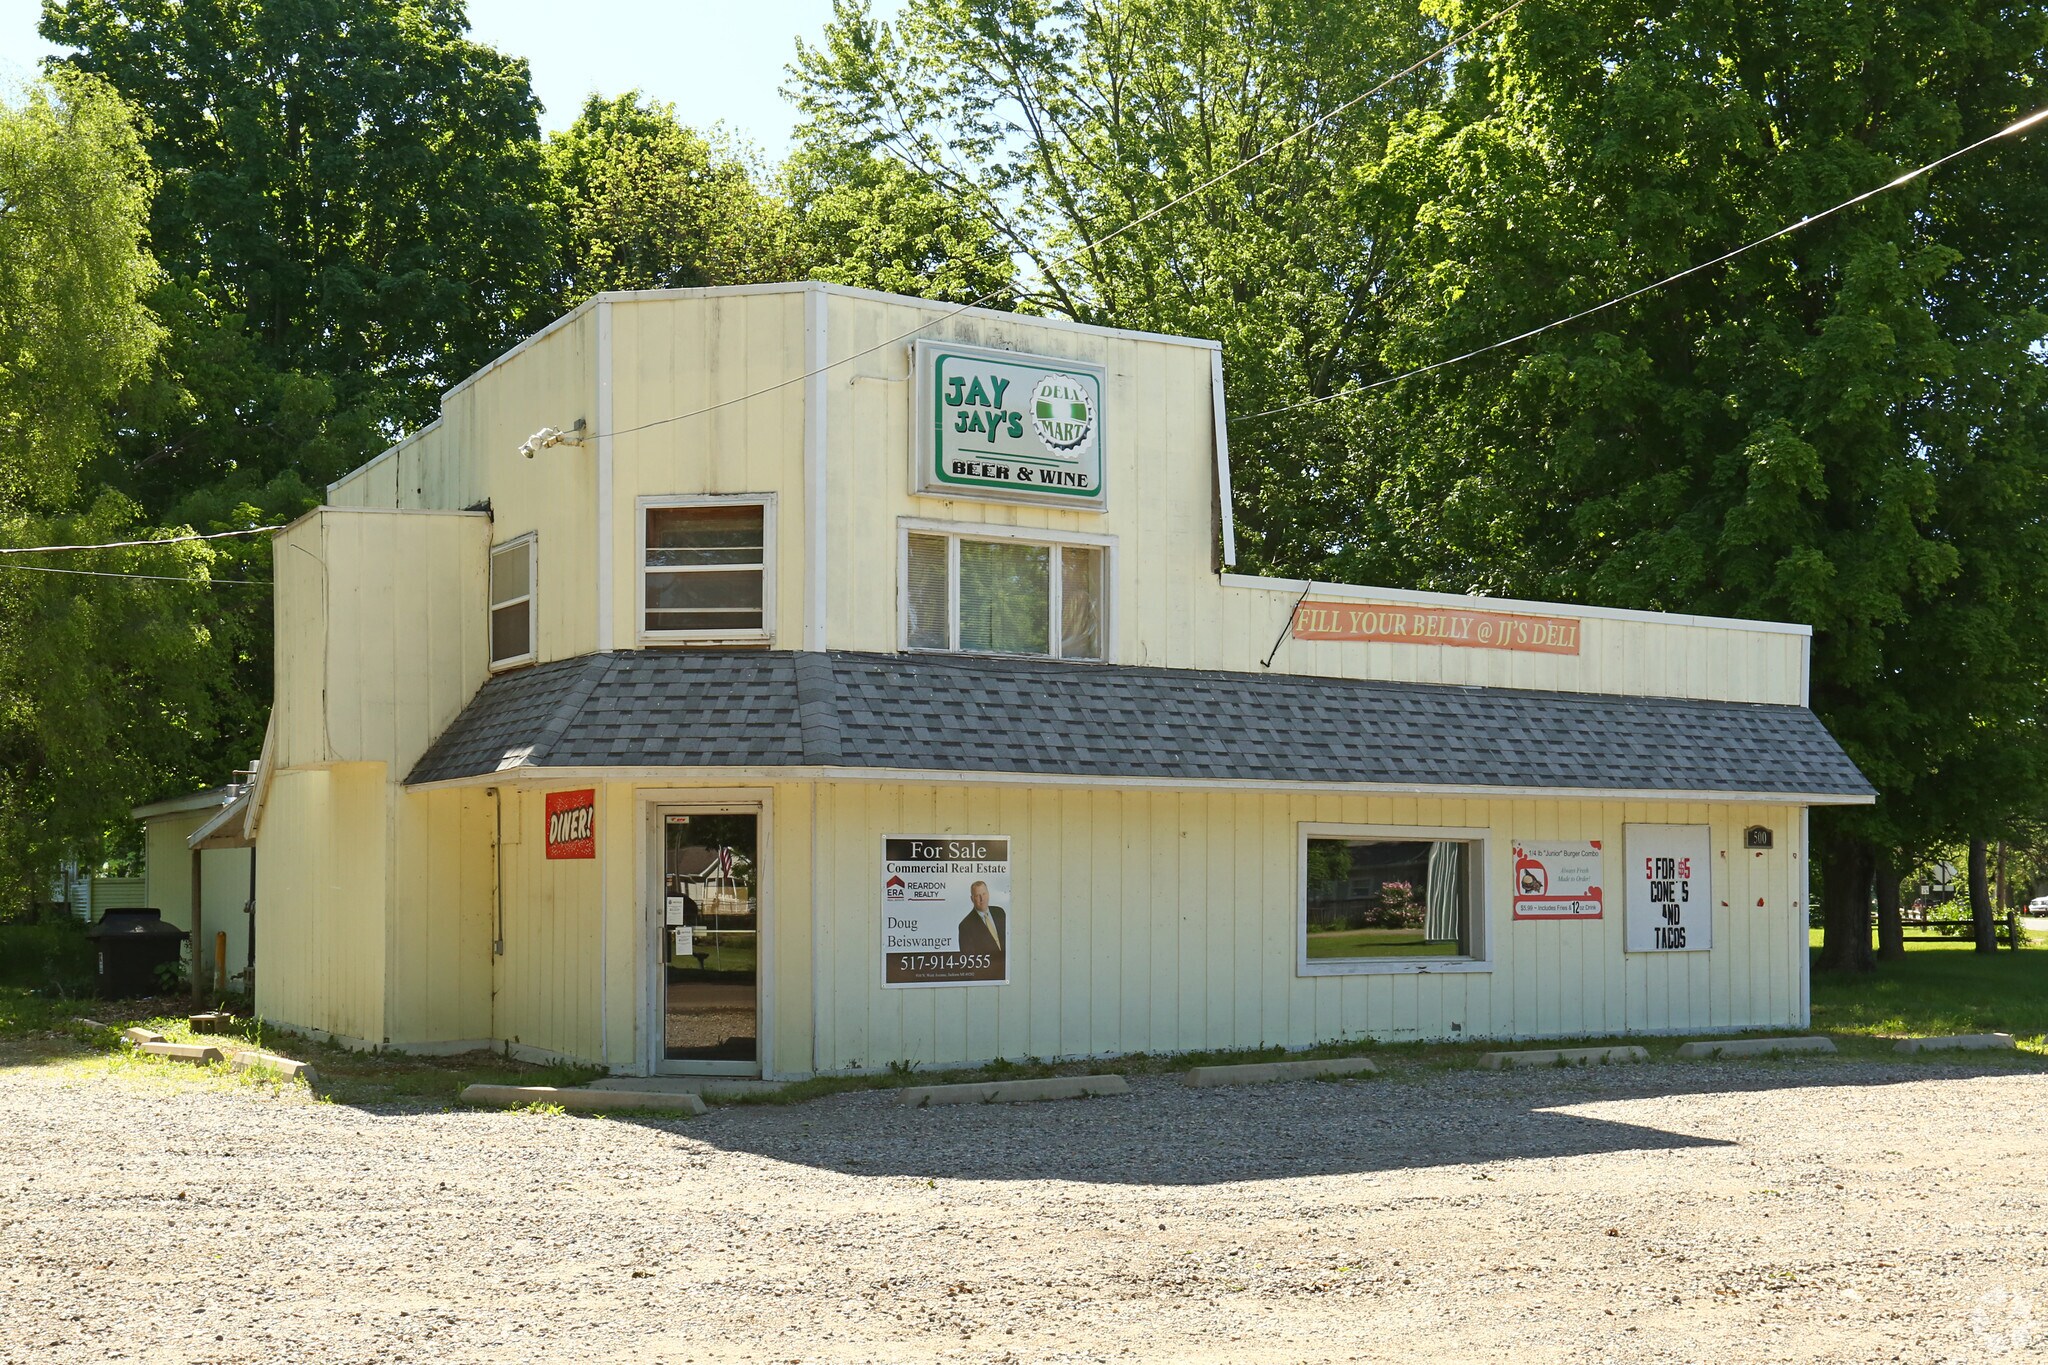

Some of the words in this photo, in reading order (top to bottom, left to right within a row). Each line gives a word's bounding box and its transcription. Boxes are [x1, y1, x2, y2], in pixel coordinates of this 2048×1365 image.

[945, 375, 1010, 410] JAY
[1040, 385, 1080, 401] DELI
[954, 410, 1024, 443] JAY'S
[1041, 420, 1083, 441] MART
[952, 459, 1010, 479] BEER
[1017, 466, 1034, 482] &
[1039, 469, 1089, 488] WINE
[1296, 608, 1343, 634] FILL
[1349, 611, 1407, 636] YOUR
[1410, 614, 1475, 640] BELLY
[1477, 622, 1493, 643] @
[1496, 619, 1529, 646] JJ'S
[1531, 622, 1577, 648] DELI
[549, 803, 594, 844] DINER!
[910, 841, 943, 859] For
[948, 841, 987, 859] Sale
[1564, 850, 1580, 858] Burger
[886, 862, 948, 874] Commercial
[951, 863, 973, 874] Real
[976, 863, 1006, 874] Estate
[1645, 857, 1653, 880] 5
[1656, 857, 1675, 880] FOR
[1678, 857, 1690, 879] $5
[887, 888, 904, 897] ERA
[907, 881, 946, 890] REARDON
[1572, 901, 1580, 914] 12
[888, 917, 918, 932] Doug
[888, 935, 952, 949] Beiswanger
[1654, 927, 1686, 949] TACOS
[900, 954, 991, 971] 517-914-9555
